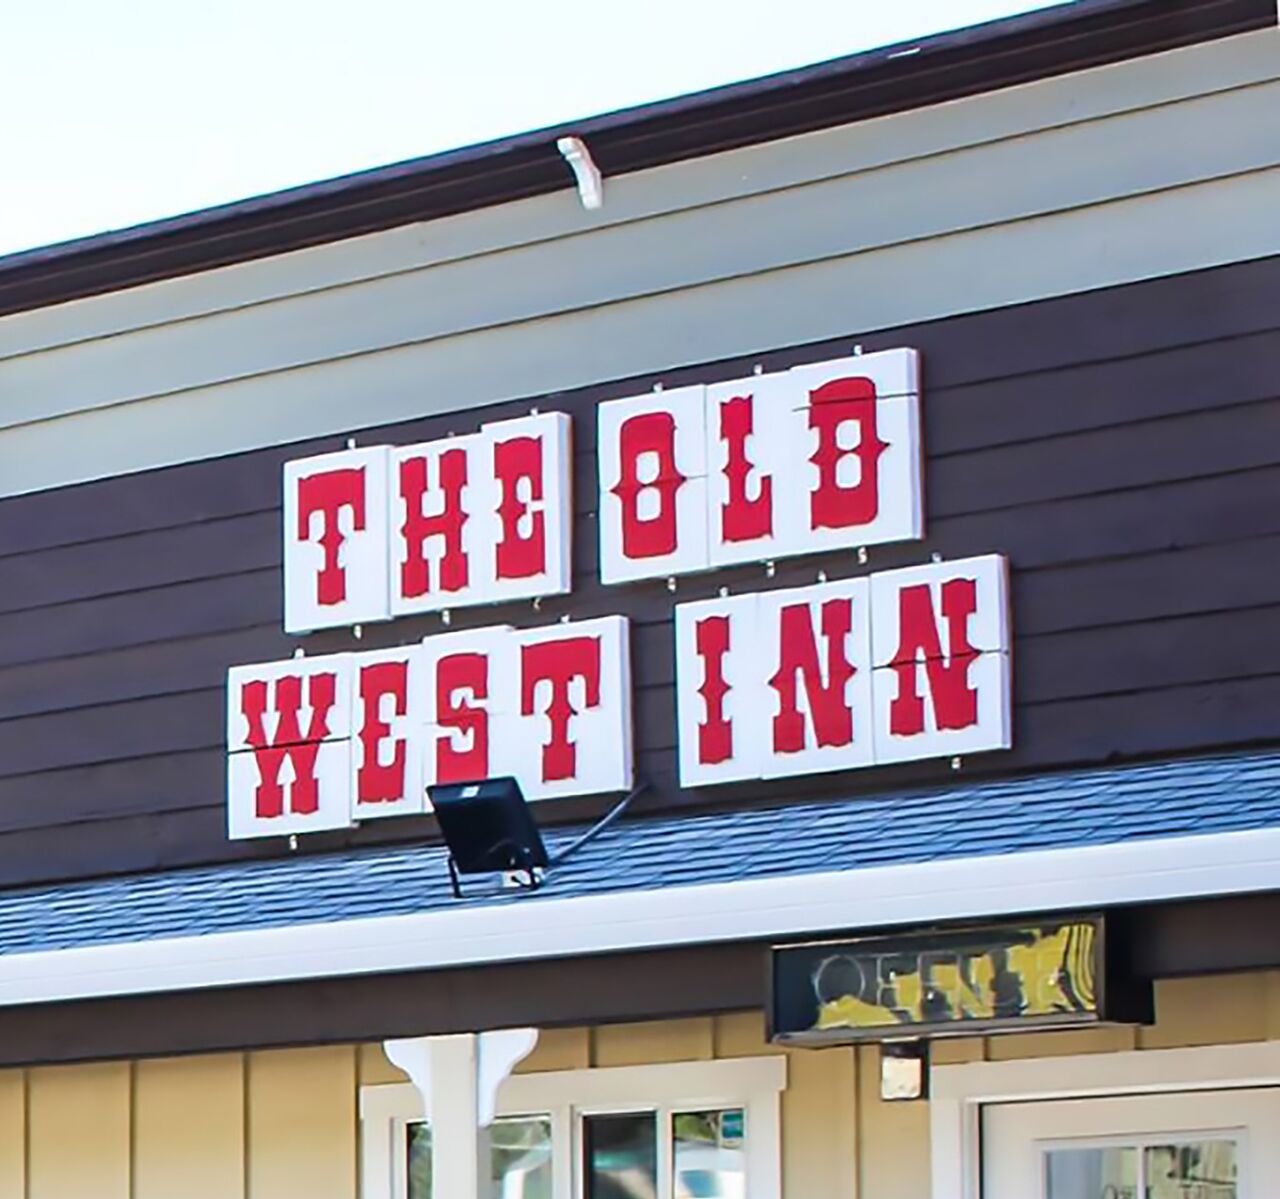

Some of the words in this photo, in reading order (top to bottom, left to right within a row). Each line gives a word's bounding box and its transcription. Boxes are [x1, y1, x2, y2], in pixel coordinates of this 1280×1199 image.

[297, 436, 546, 606] THE
[609, 376, 890, 560] OLD
[241, 635, 601, 820] WEST
[697, 578, 983, 766] INN
